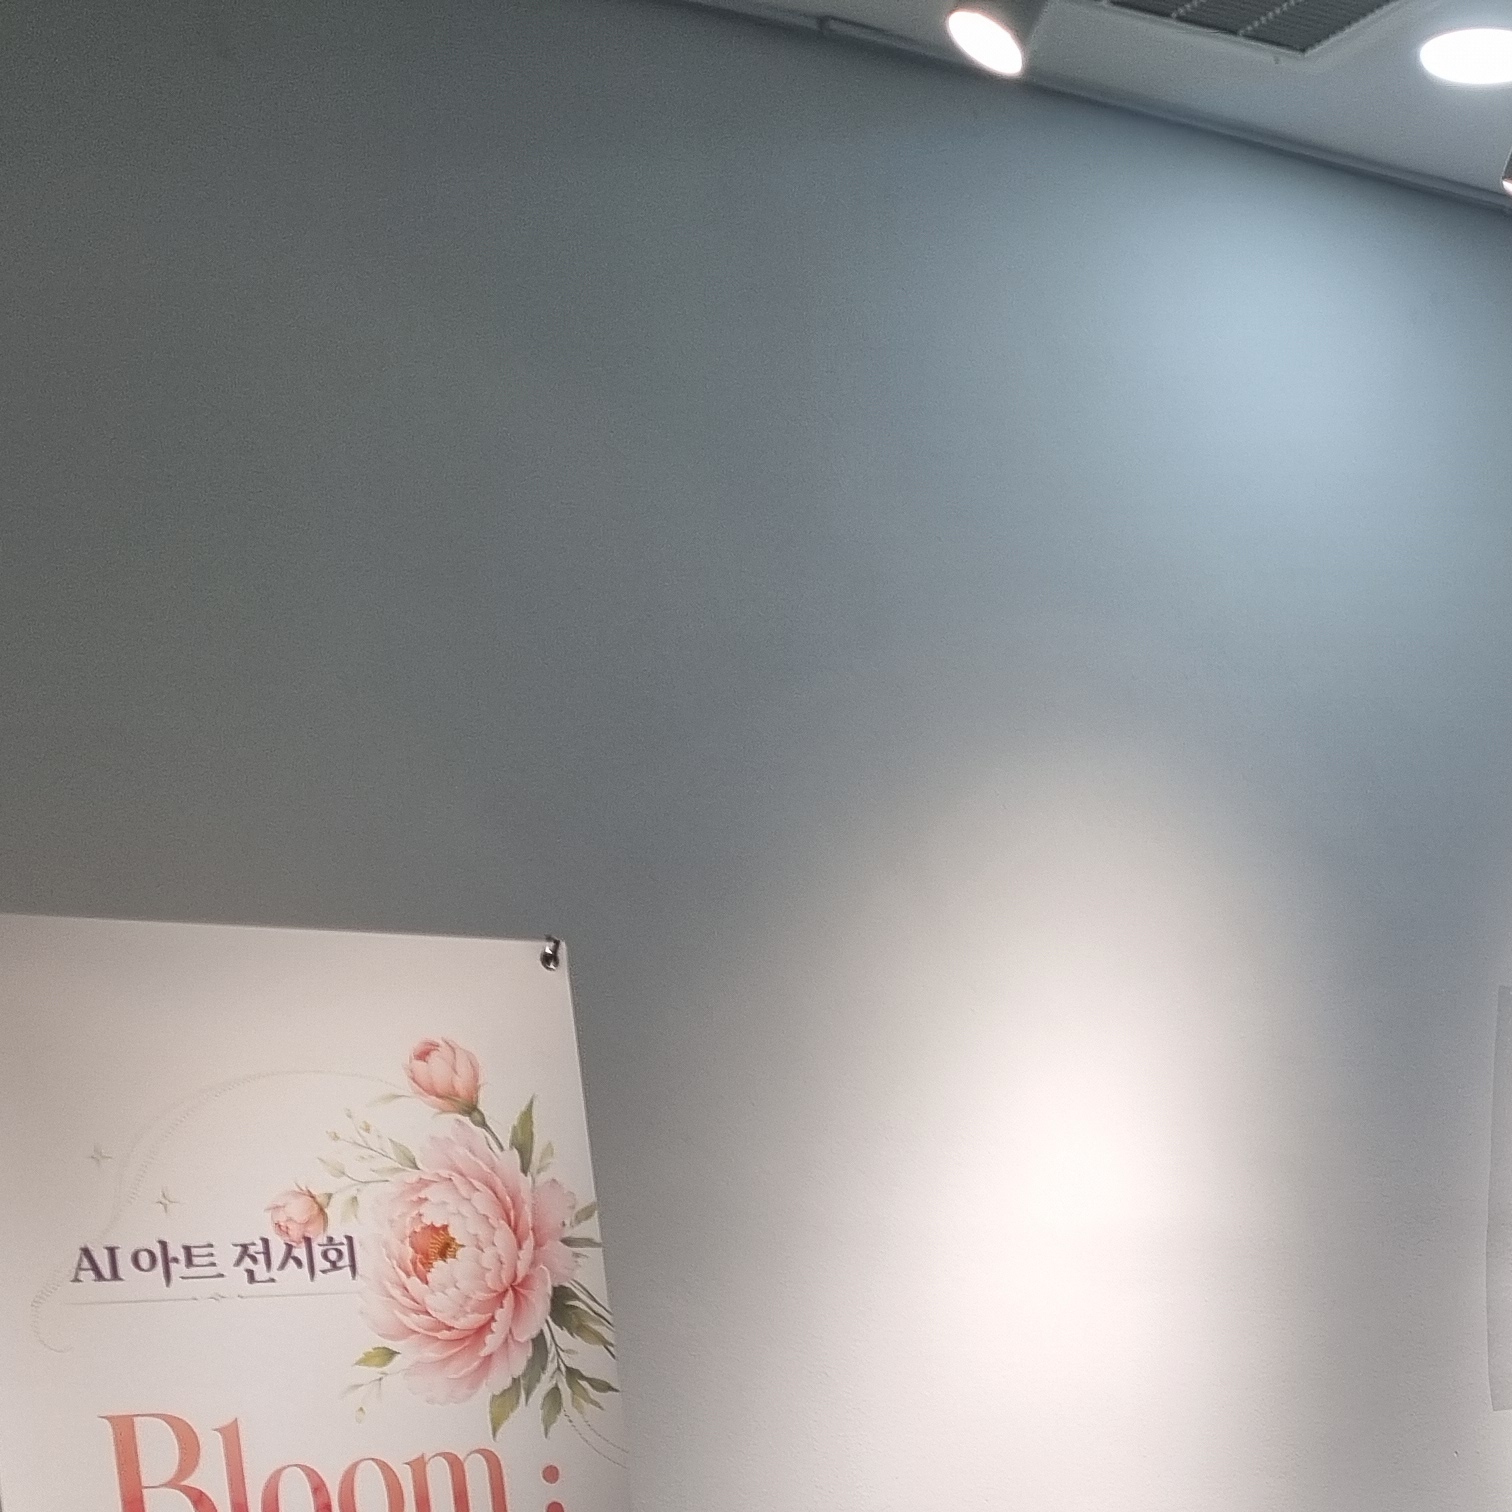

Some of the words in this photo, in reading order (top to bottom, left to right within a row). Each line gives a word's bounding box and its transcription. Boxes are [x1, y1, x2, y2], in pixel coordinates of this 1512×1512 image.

[70, 1243, 125, 1284] AI
[130, 1238, 225, 1289] 아트
[232, 1235, 361, 1287] 전시회
